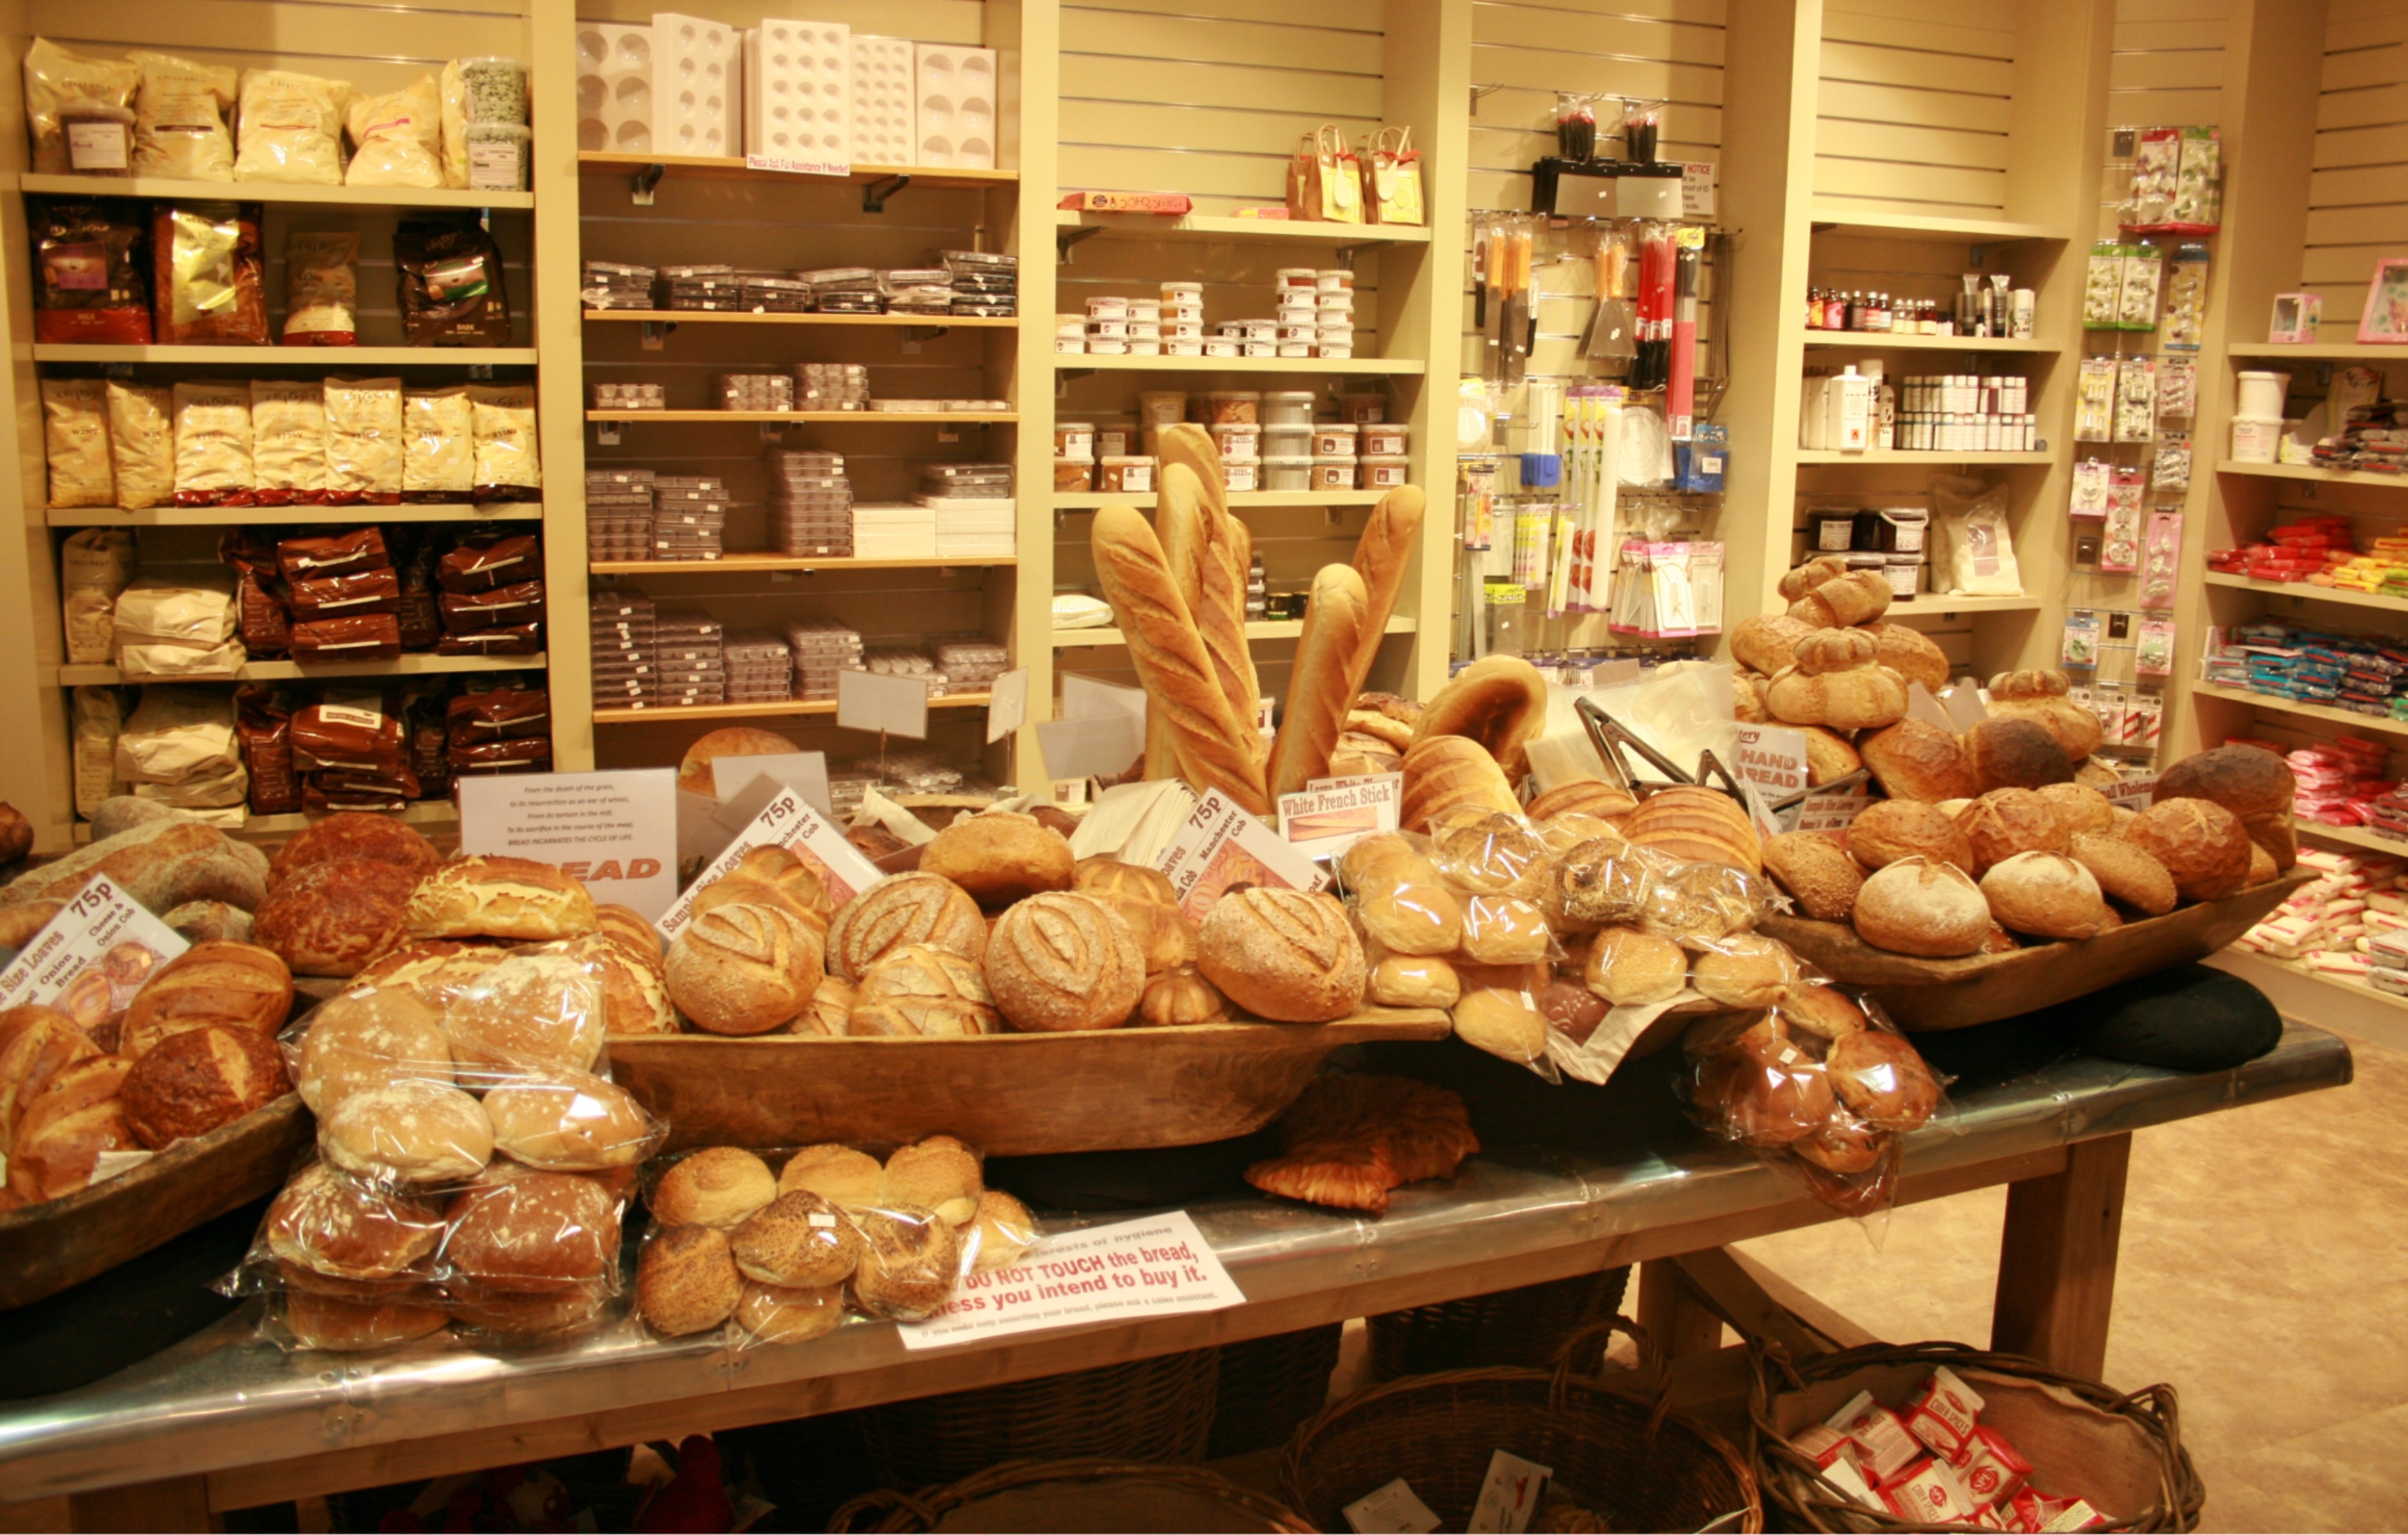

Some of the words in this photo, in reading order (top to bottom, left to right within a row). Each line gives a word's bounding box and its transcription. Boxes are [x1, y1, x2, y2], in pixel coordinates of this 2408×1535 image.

[1688, 164, 1710, 175] NOTICE
[1120, 197, 1151, 209] CHOC
[1740, 749, 1798, 771] HAND
[518, 799, 527, 807] its
[527, 798, 567, 806] resurrection
[599, 796, 608, 804] of
[575, 784, 584, 792] of
[596, 783, 615, 792] grain,
[1282, 799, 1314, 817] White
[1317, 789, 1357, 811] French
[1361, 784, 1390, 805] Stick
[759, 796, 795, 827] 75p
[1188, 796, 1221, 830] 75p
[508, 838, 531, 846] BREAD
[531, 836, 572, 845] INCARNATES
[587, 834, 607, 843] CYCLE
[619, 833, 634, 841] LIFE.
[525, 824, 553, 834] sacrifice
[595, 822, 604, 831] of
[778, 812, 811, 848] nchester
[802, 822, 819, 840] Cob
[1199, 810, 1237, 860] Manchester
[1231, 819, 1246, 837] Cob
[562, 858, 661, 882] EAD
[1161, 845, 1186, 877] oaves
[662, 897, 693, 933] Sampl
[715, 841, 753, 874] Loaves
[1180, 870, 1197, 887] Cob
[1308, 873, 1323, 893] oaf
[70, 882, 113, 918] 75p
[89, 911, 116, 937] Cheese
[116, 901, 124, 910] &
[97, 923, 121, 946] Onion
[119, 907, 135, 924] Cob
[1, 968, 29, 993] Size
[21, 930, 65, 971] Loaves
[40, 954, 73, 985] Onion
[55, 956, 87, 988] Bread
[1031, 1241, 1089, 1258] terests
[1093, 1237, 1108, 1247] of
[1114, 1226, 1173, 1243] hygiene
[998, 1267, 1032, 1286] NOT
[1038, 1254, 1105, 1279] TOUCH
[1107, 1251, 1139, 1268] the
[1139, 1240, 1199, 1264] bread,
[991, 1289, 1033, 1311] you
[1036, 1274, 1108, 1300] intend
[1112, 1272, 1136, 1288] to
[1139, 1267, 1178, 1289] buy
[1182, 1264, 1208, 1283] it.
[932, 1327, 950, 1337] you
[951, 1322, 975, 1333] need
[976, 1318, 996, 1330] help
[998, 1311, 1041, 1325] selecting
[1042, 1307, 1062, 1319] your
[1094, 1298, 1125, 1312] please
[1126, 1296, 1142, 1307] ask
[1152, 1294, 1175, 1305] sales
[1929, 1398, 1949, 1418] CIDER
[1946, 1412, 1970, 1435] SPICES
[1924, 1500, 1940, 1523] SPICES
